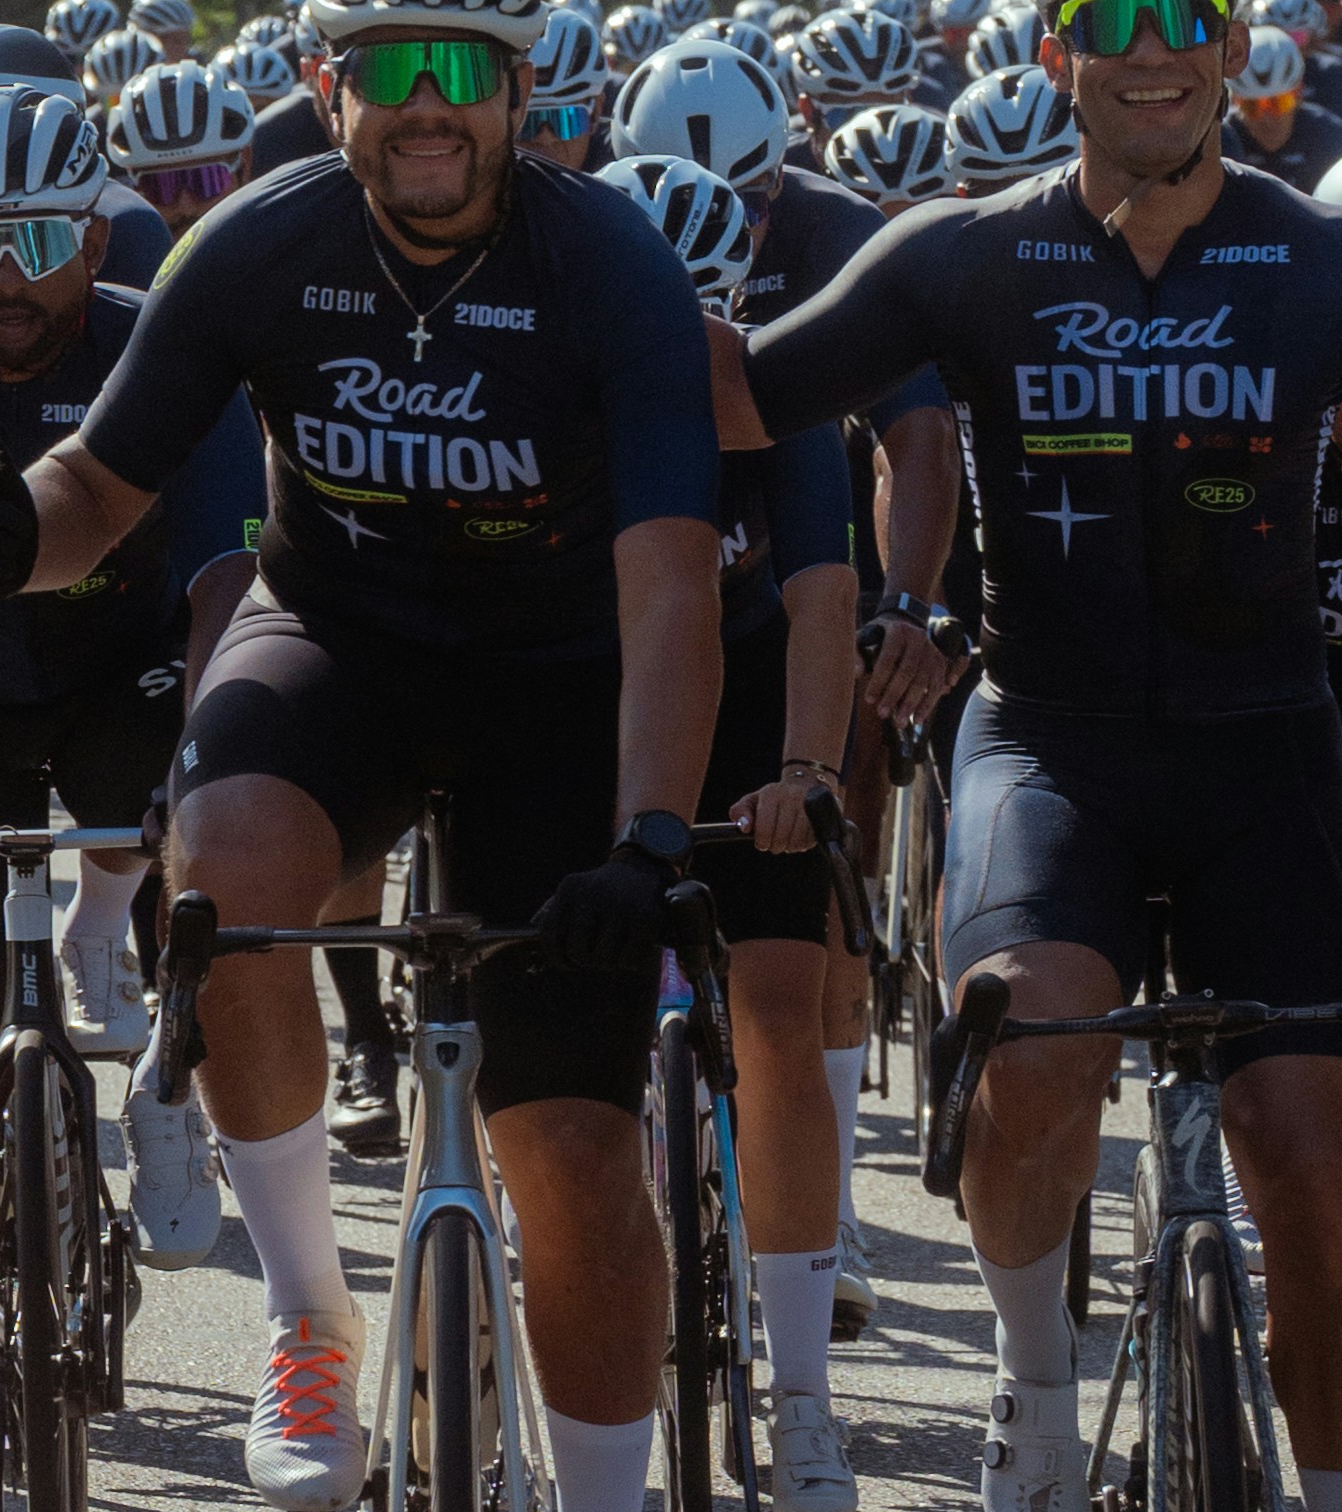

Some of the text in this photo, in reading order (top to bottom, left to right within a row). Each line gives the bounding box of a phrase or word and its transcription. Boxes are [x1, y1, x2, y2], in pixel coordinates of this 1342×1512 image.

[1016, 240, 1291, 265] GOBIK 21DOCE
[302, 285, 537, 332] GOBIK 21DOCE
[1032, 301, 1236, 359] Road
[41, 403, 87, 424] 21DO
[317, 357, 488, 424] Road
[1014, 362, 1276, 423] EDITION
[294, 412, 542, 493] EDITION
[1192, 482, 1246, 505] RE25
[22, 952, 39, 1008] BMC
